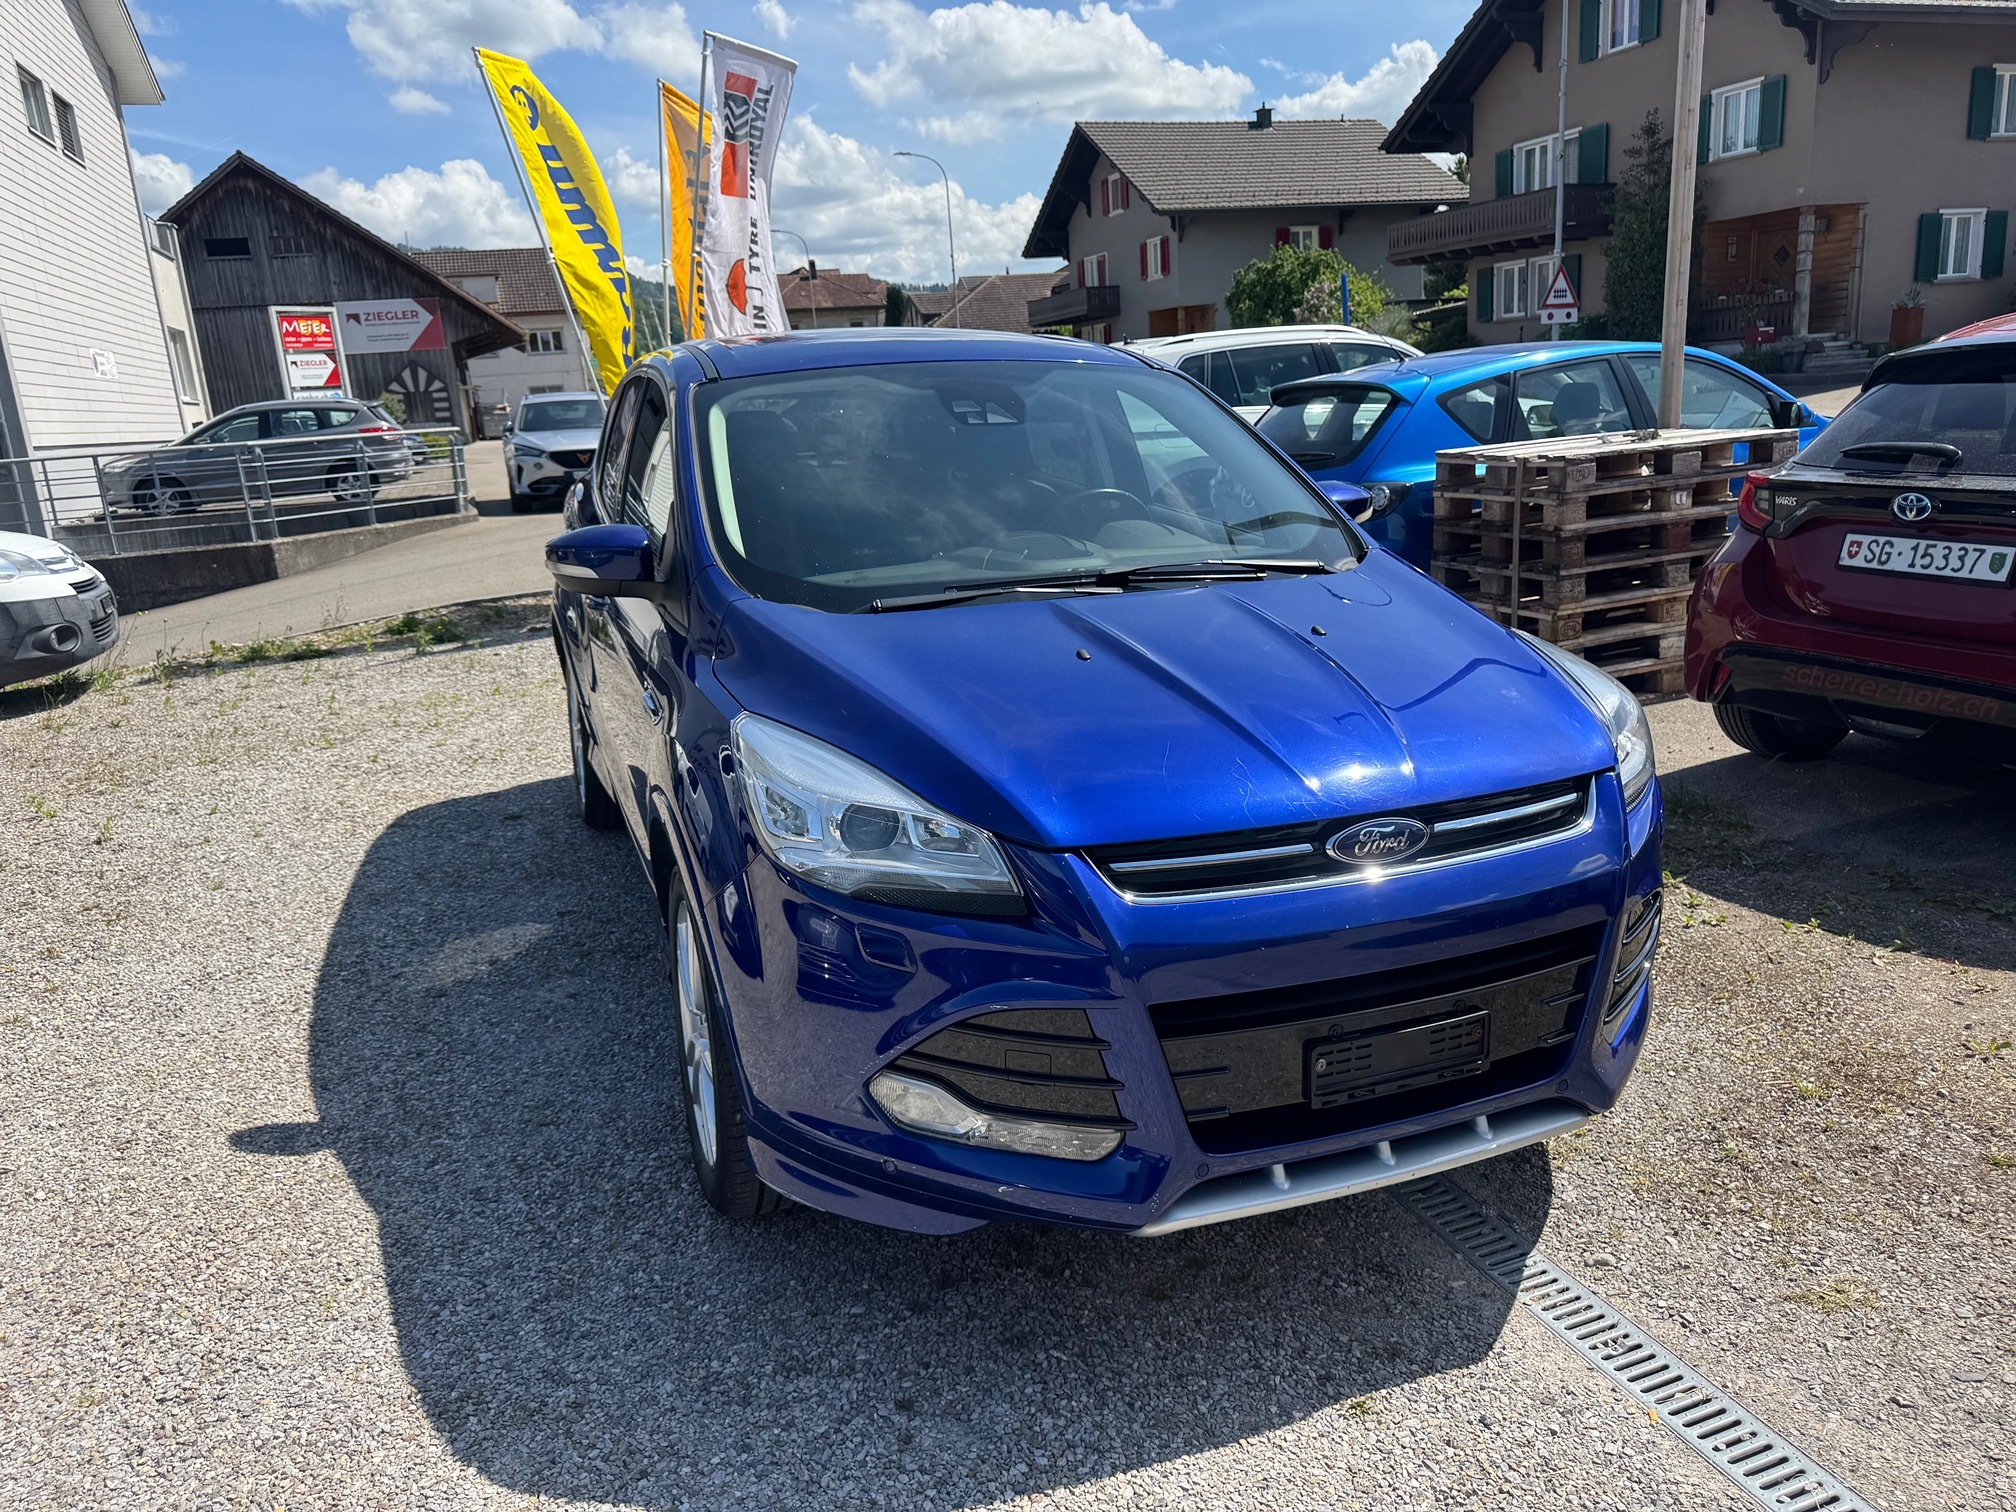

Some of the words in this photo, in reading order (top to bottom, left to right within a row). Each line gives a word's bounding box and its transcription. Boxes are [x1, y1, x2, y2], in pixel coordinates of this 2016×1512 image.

[746, 84, 774, 200] UNIROYAL
[748, 216, 761, 275] TYRE
[363, 309, 420, 322] ZIEGLER
[300, 359, 328, 367] ZIEGLER
[1775, 495, 1798, 506] YARIS
[1783, 664, 2001, 720] scherrer-holz.ch
[1354, 825, 1410, 857] Ford
